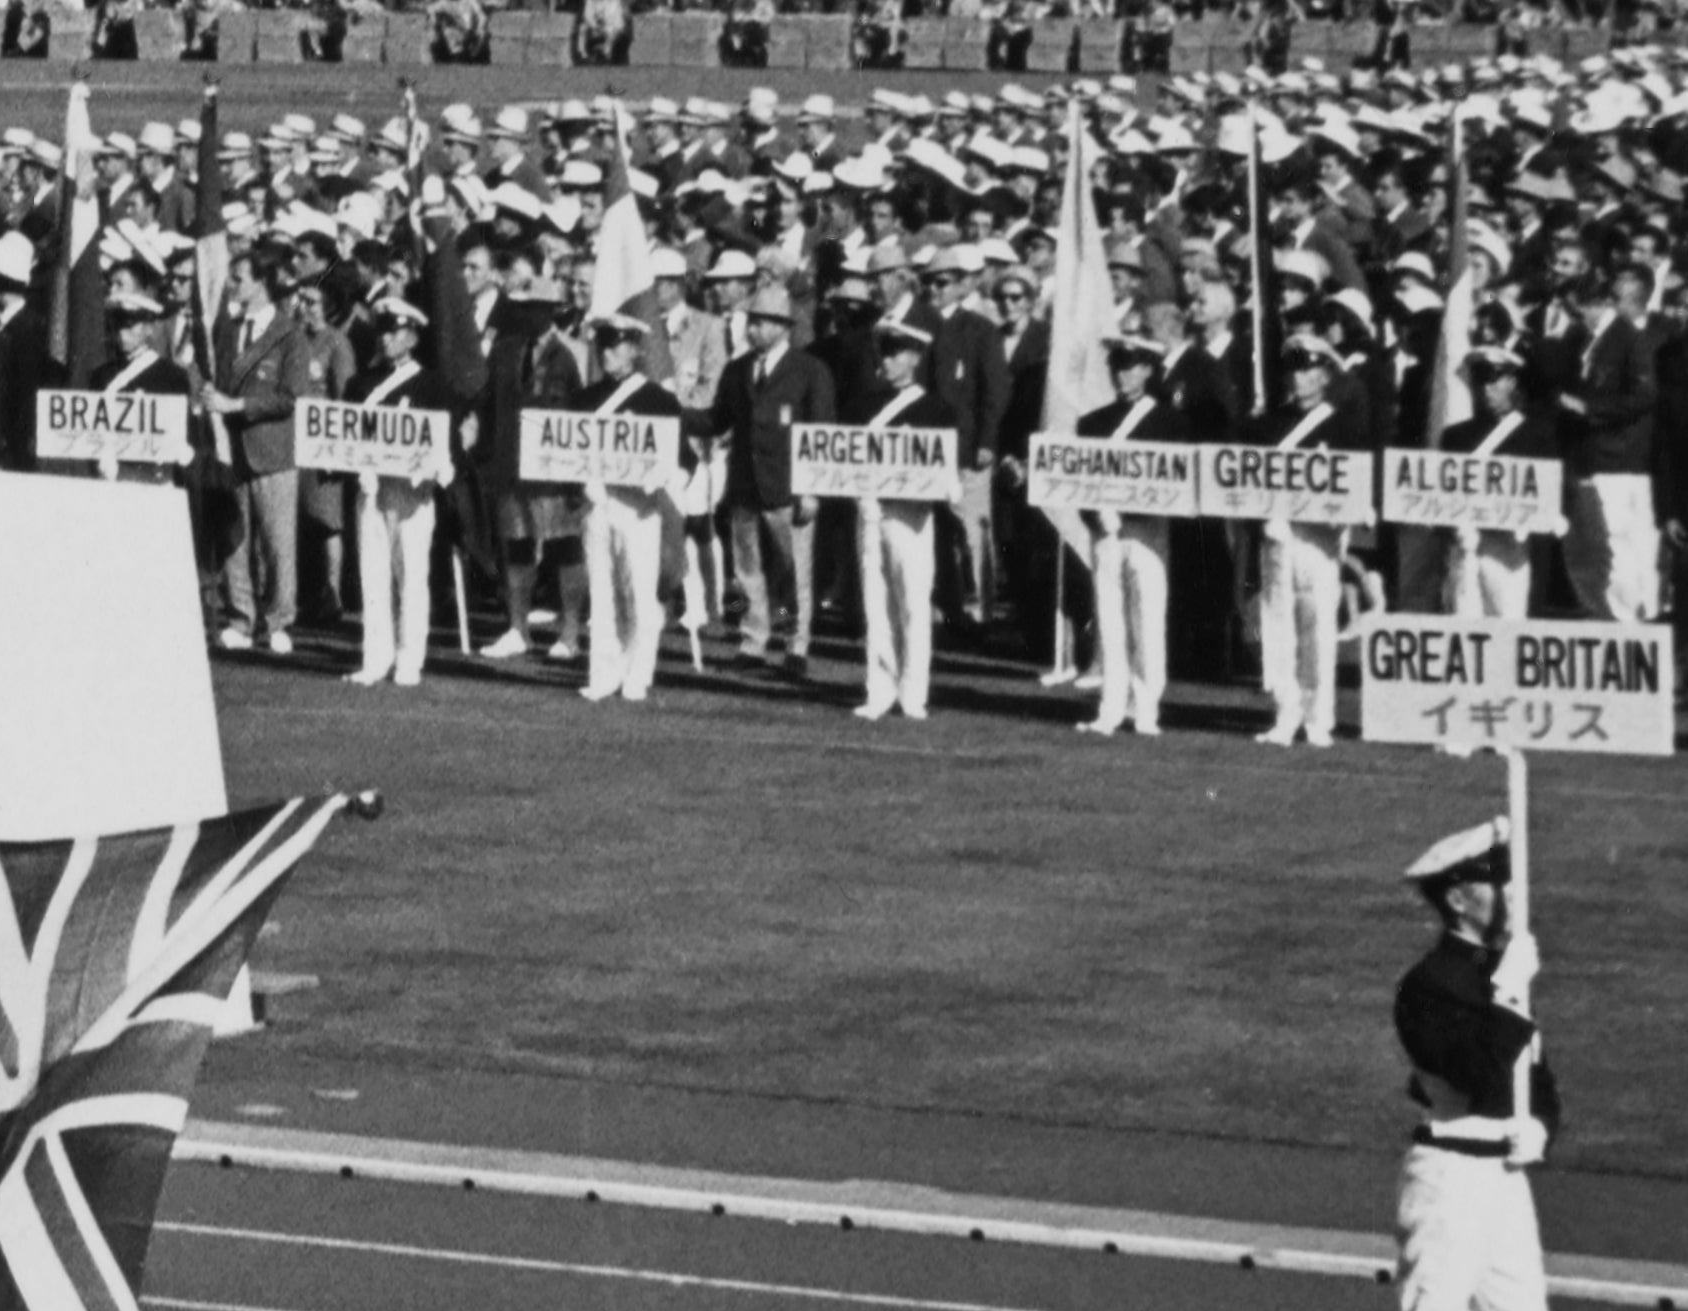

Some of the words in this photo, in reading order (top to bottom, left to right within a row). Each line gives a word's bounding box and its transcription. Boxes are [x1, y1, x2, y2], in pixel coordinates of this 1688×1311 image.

[49, 394, 166, 434] BRAZIL
[306, 404, 433, 448] BERMUDA
[540, 417, 658, 455] AUSTRIA
[798, 429, 946, 468] ARGENTINA
[1034, 444, 1188, 482] AFGHANISTAN
[1214, 447, 1350, 495] GREECE
[1396, 456, 1539, 498] ALGERIA
[1368, 630, 1491, 684] GREAT
[1517, 636, 1659, 692] BRITAIN
[1422, 695, 1610, 742] イギリス
